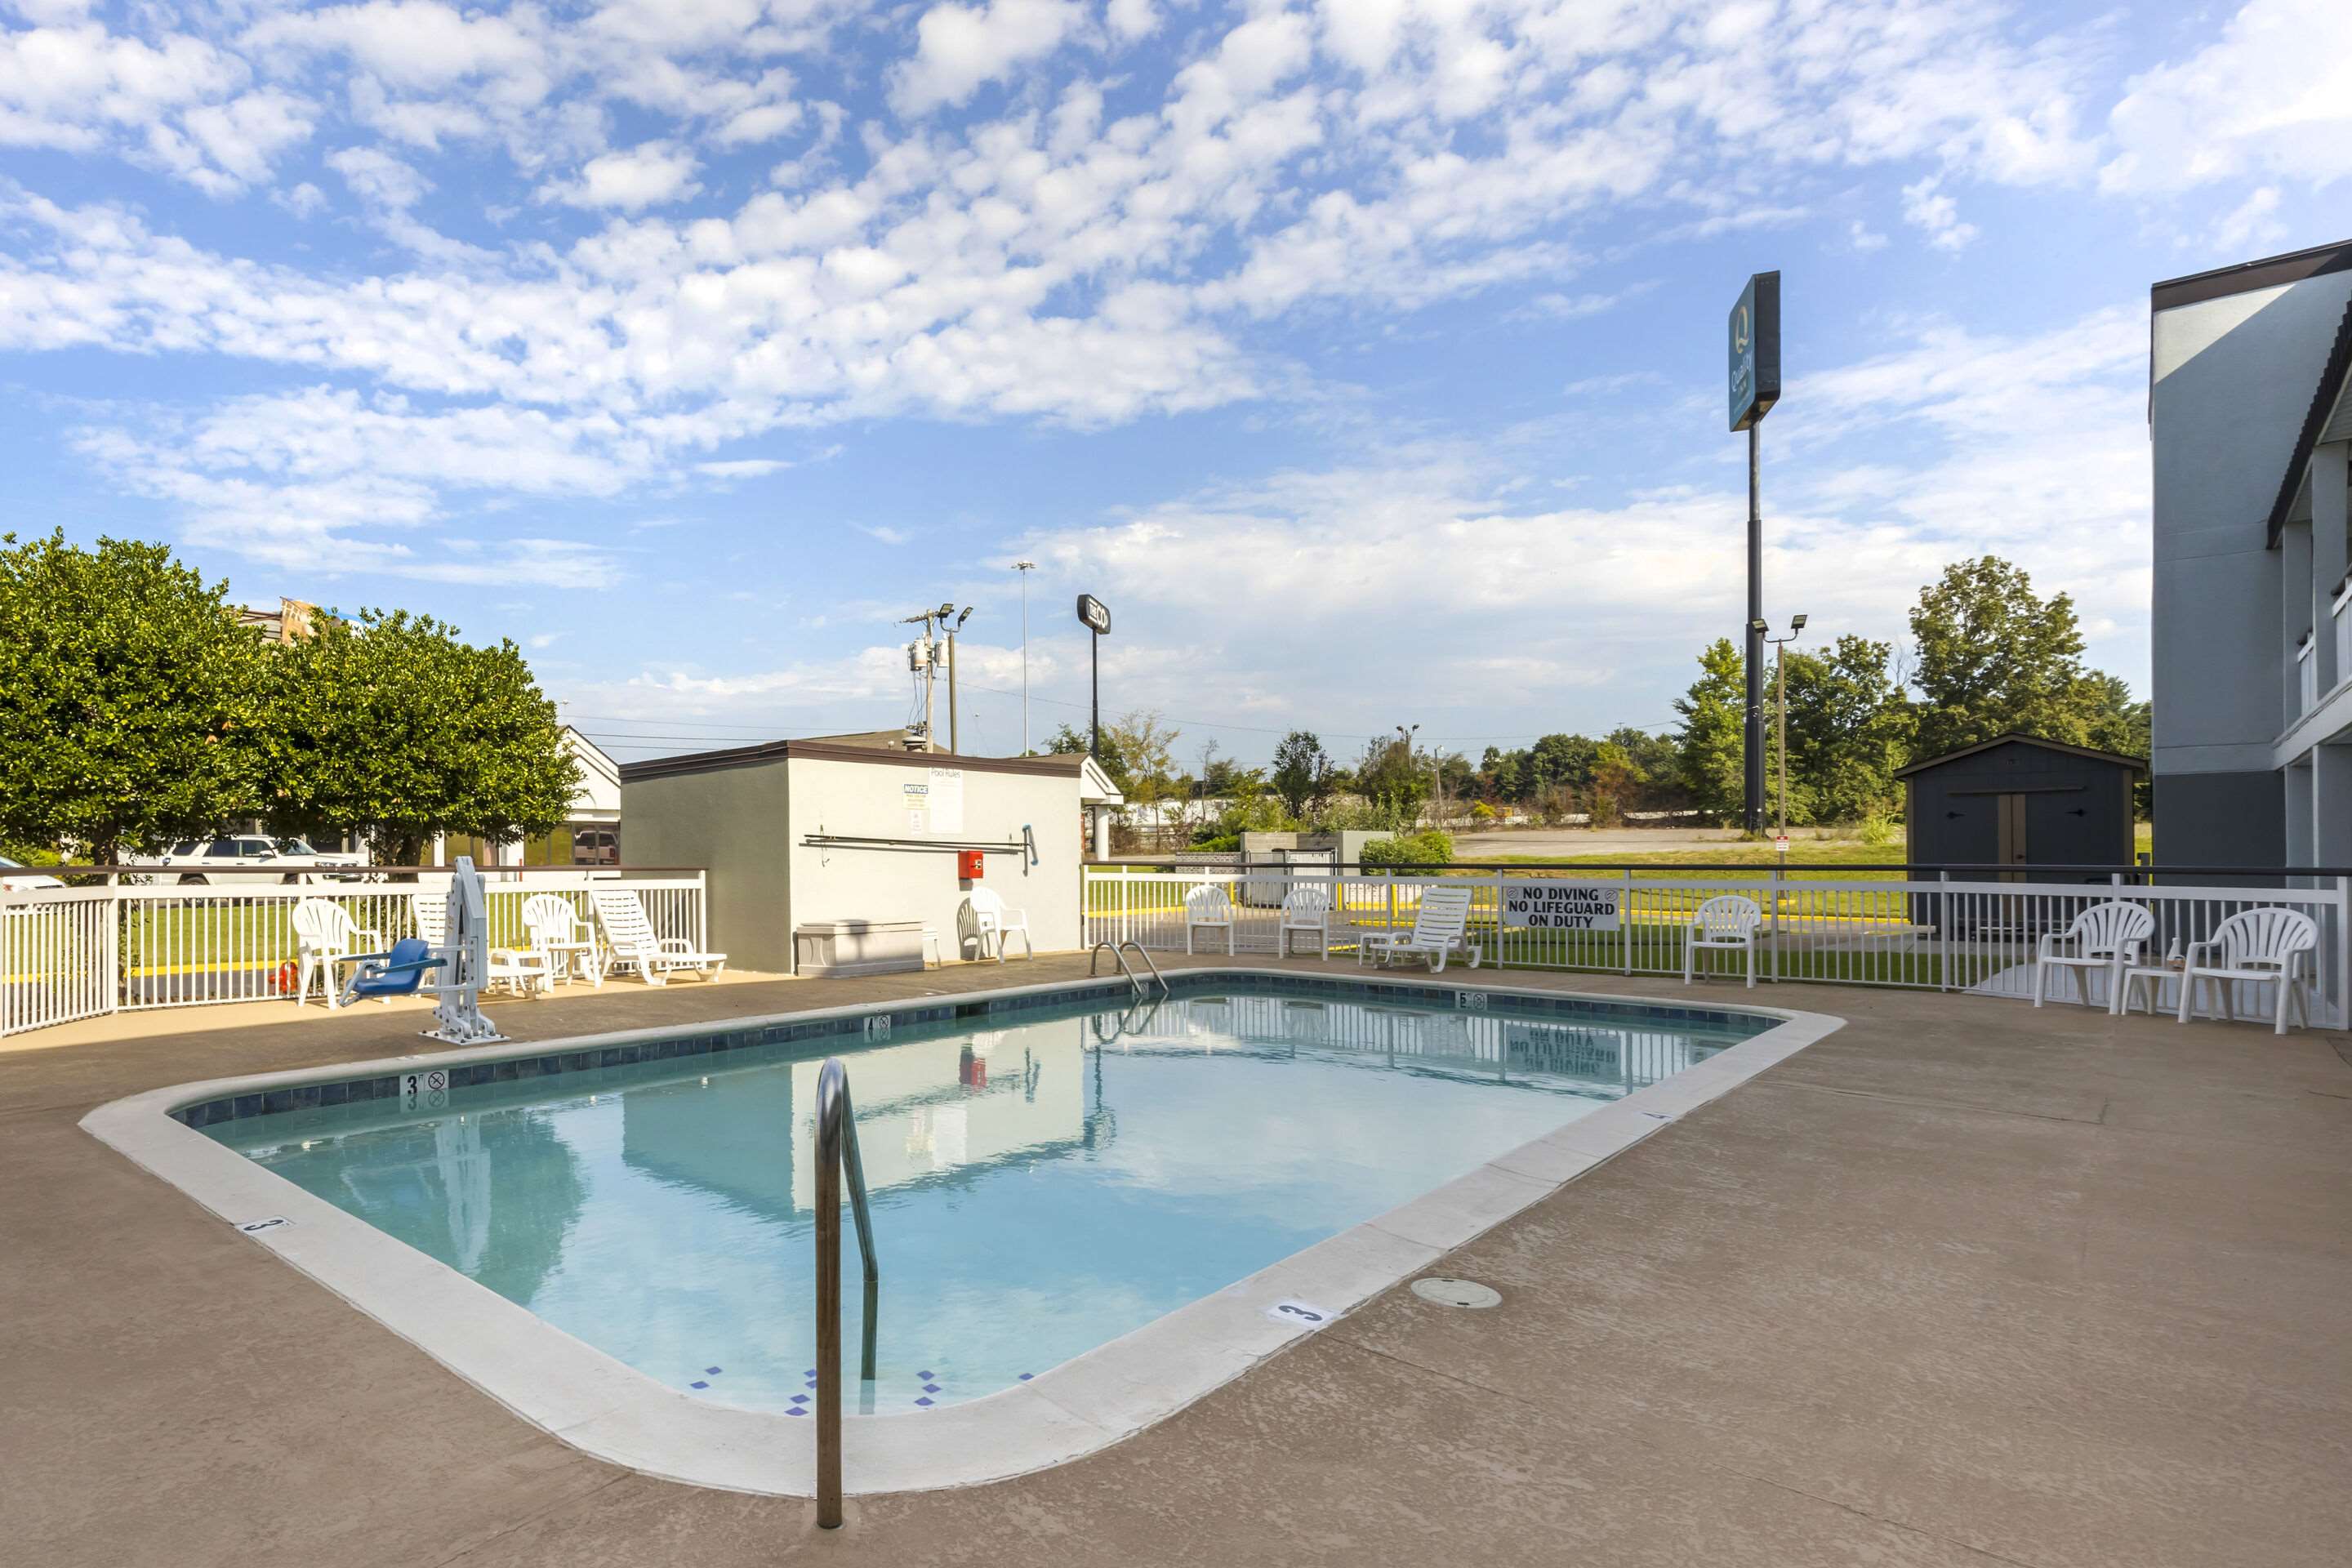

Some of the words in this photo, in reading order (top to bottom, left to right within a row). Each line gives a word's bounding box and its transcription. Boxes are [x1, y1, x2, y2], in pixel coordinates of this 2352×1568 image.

[931, 768, 944, 777] Pool
[946, 769, 961, 778] Rules
[904, 785, 929, 794] NOTICE
[1523, 888, 1543, 899] NO
[1548, 888, 1598, 901] DIVING
[1508, 901, 1528, 912] NO
[1534, 902, 1615, 915] LIFEGUARD
[1528, 915, 1548, 926] ON
[1554, 915, 1593, 928] DUTY
[407, 1076, 417, 1095] 3
[1278, 1305, 1323, 1321] 3
